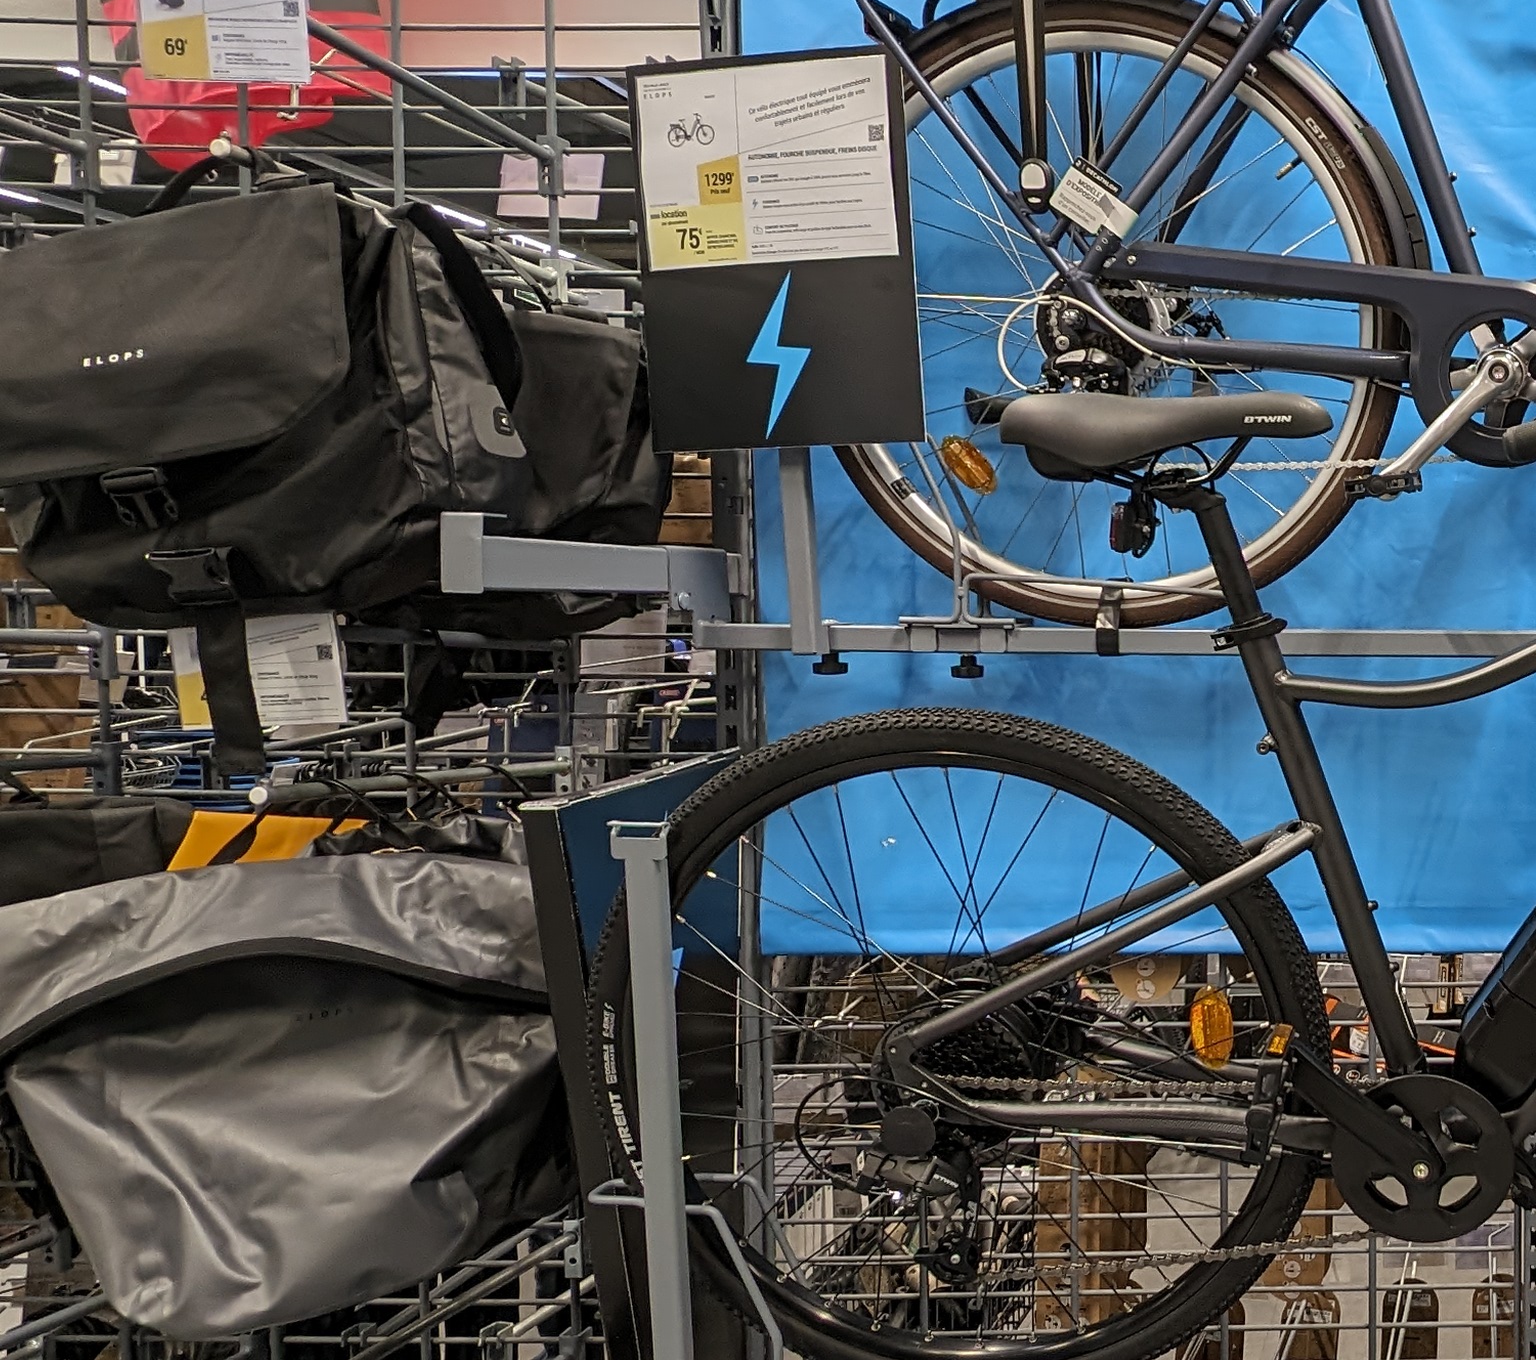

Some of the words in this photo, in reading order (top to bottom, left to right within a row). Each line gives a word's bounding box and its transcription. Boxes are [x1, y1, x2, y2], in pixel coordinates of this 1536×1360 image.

[1304, 116, 1328, 140] CST
[660, 209, 688, 219] location
[83, 348, 144, 367] ELOPS
[608, 1091, 637, 1156] TIRENT
